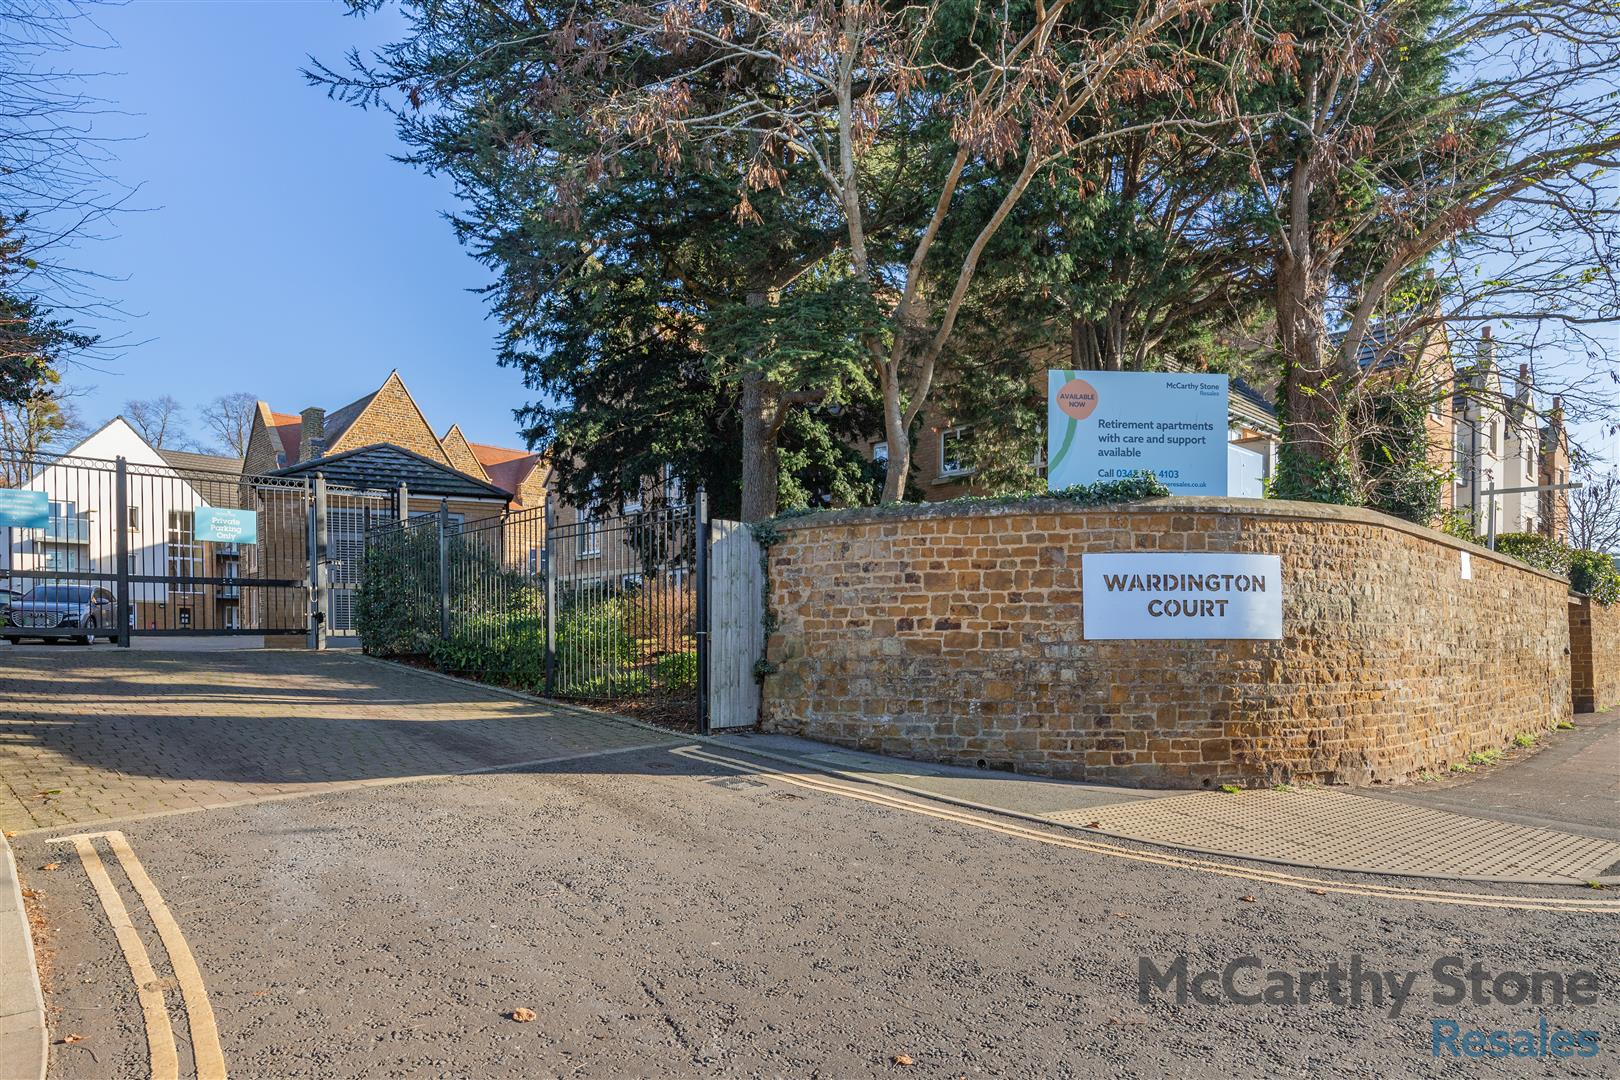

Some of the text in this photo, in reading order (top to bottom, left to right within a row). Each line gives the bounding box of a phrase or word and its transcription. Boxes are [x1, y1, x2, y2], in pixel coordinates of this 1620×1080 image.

[1166, 382, 1198, 391] McCarthy
[1060, 393, 1095, 401] AVAILABLE
[1098, 419, 1214, 433] Retirement apartments
[1098, 433, 1206, 447] with care and support
[1098, 447, 1142, 457] available
[1097, 469, 1115, 478] Call
[1158, 470, 1179, 479] 4103
[211, 517, 241, 525] Private
[210, 524, 242, 534] Parking
[216, 532, 236, 541] Only
[1103, 574, 1266, 592] WARDINGTON
[1147, 599, 1229, 617] COURT
